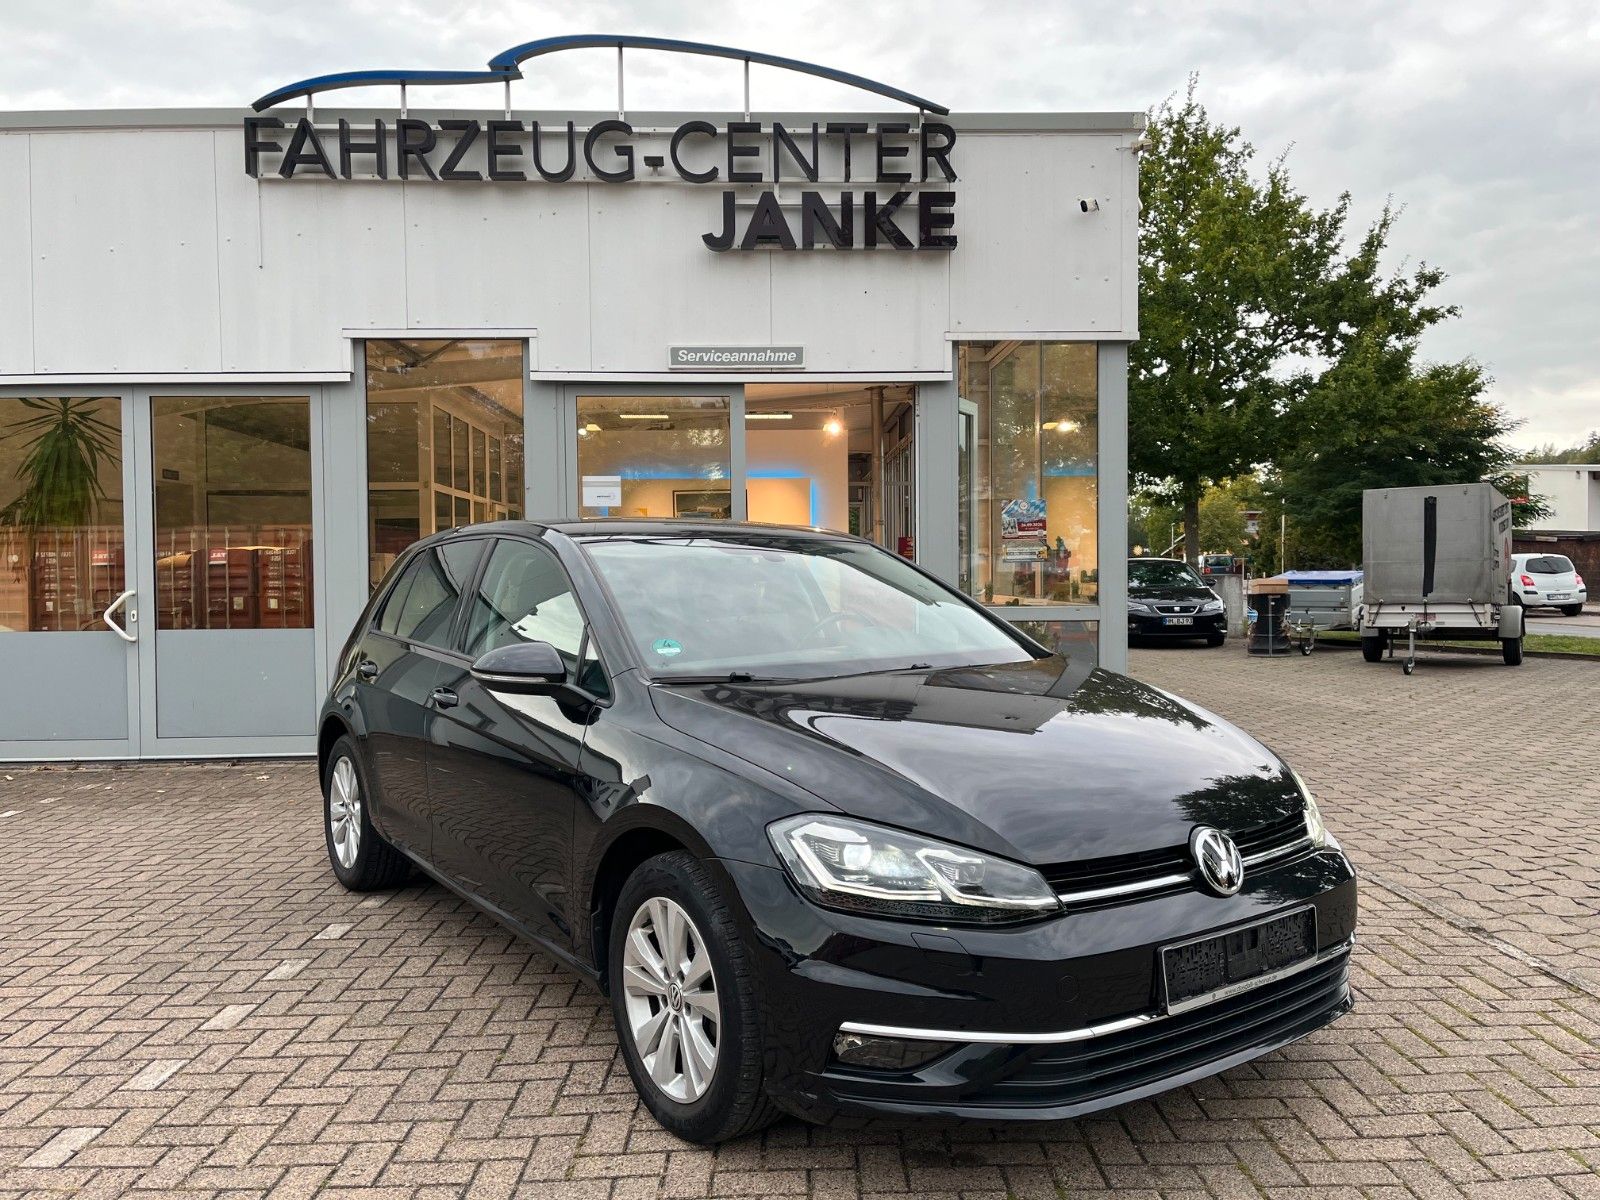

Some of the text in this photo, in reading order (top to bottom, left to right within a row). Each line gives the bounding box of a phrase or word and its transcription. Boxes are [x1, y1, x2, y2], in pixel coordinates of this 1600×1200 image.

[244, 117, 958, 184] FAHRZEUG-CENTER
[702, 191, 958, 252] JANKE
[678, 350, 797, 362] Serviceannahme
